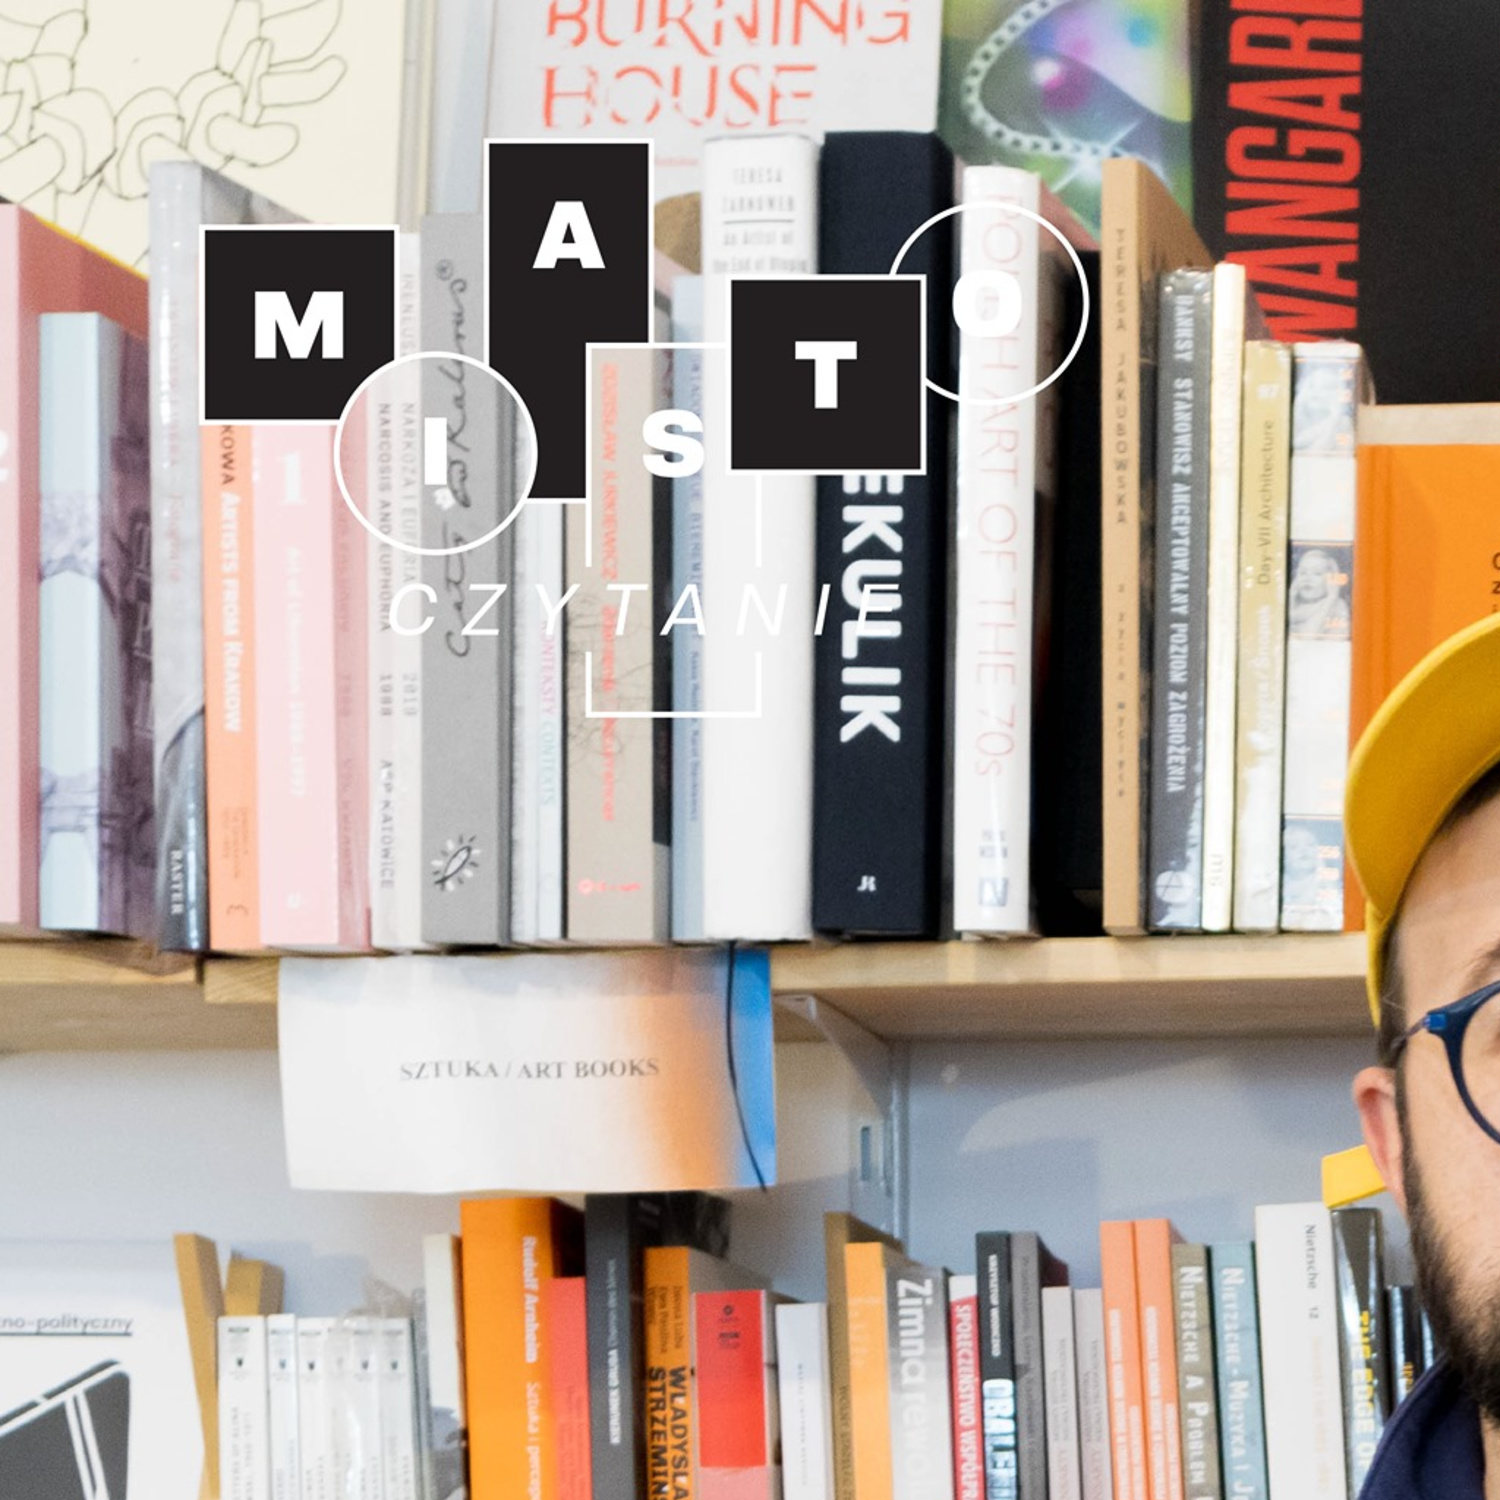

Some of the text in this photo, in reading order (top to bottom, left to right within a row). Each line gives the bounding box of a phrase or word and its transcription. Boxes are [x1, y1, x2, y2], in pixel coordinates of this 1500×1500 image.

[546, 0, 909, 56] BURNING
[543, 65, 817, 128] HOUSE
[1226, 0, 1363, 343] WANGAR
[1114, 228, 1129, 526] TERESA JAKUBOWSKA
[401, 402, 415, 488] NARKOZA
[1257, 419, 1277, 521] Architecture
[378, 402, 393, 632] NARCOSIS AND EUPHORIA
[1166, 294, 1194, 794] BANKSY STANOWISZ POZIOM ZAGROŻENIA
[975, 390, 1020, 776] ART OF THE 70s
[167, 849, 185, 915] RASTER
[380, 800, 395, 890] KATOWICE
[400, 1058, 661, 1082] SZTUKA ART BOOKS
[522, 1237, 540, 1290] Rudolf
[1304, 1224, 1319, 1320] Nietzsche 12
[0, 1313, 133, 1332] no-polityczny
[522, 1293, 541, 1364] Arnheim
[896, 1278, 934, 1385] Zimna
[1179, 1265, 1204, 1364] NIETZSCHE
[1221, 1267, 1245, 1364] NIETZSCHE
[525, 1381, 541, 1434] Sztuka
[956, 1304, 980, 1428] SPOŁECZEŃSTWO
[1184, 1374, 1206, 1390] A
[1351, 1367, 1374, 1434] EDGE
[1187, 1401, 1209, 1484] PROBLEM
[1228, 1380, 1250, 1459] MUZYKA
